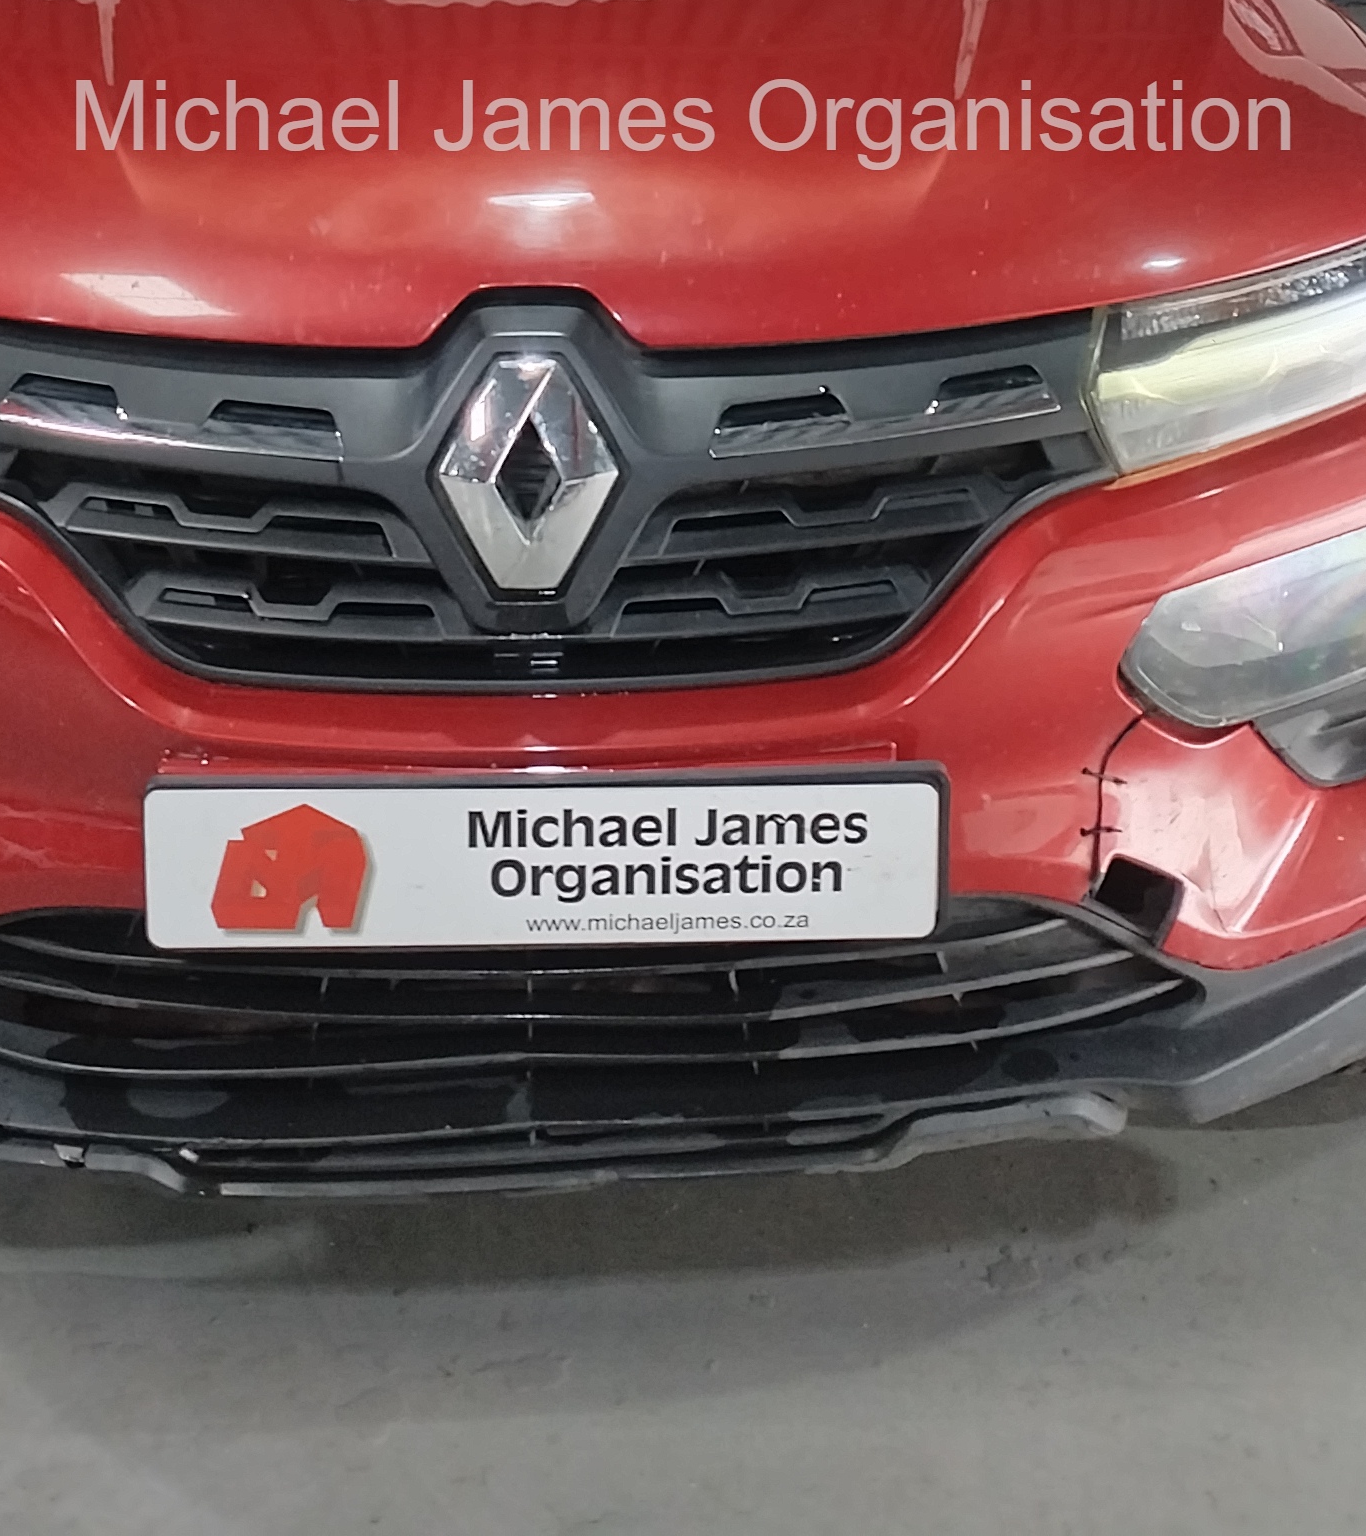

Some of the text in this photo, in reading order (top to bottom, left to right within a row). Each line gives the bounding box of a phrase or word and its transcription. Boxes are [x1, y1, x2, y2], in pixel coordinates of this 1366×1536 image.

[467, 807, 868, 849] Michael James
[490, 854, 843, 904] Organisation
[525, 912, 809, 935] www.michaeljames.co.za
